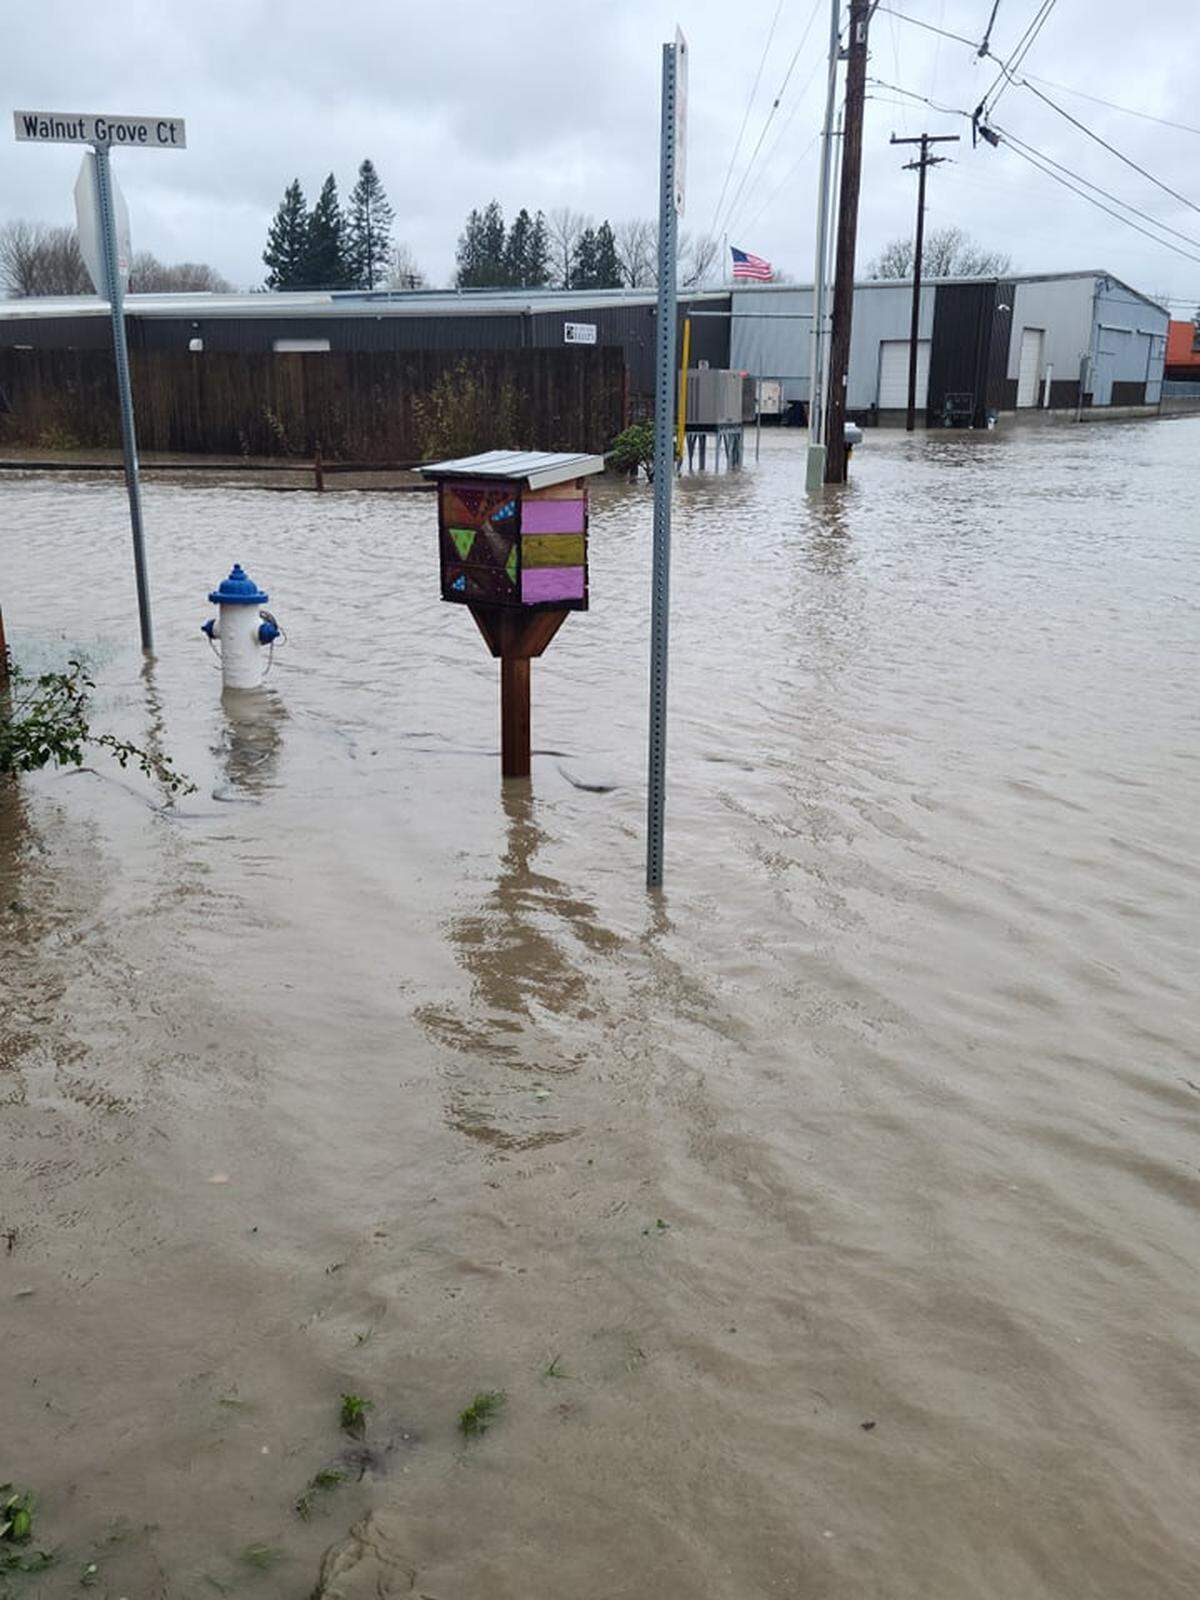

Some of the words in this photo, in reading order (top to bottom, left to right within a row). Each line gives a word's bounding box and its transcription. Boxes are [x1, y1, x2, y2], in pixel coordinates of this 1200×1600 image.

[23, 116, 86, 139] Walnut
[95, 118, 147, 142] Grove
[157, 121, 176, 143] Ct
